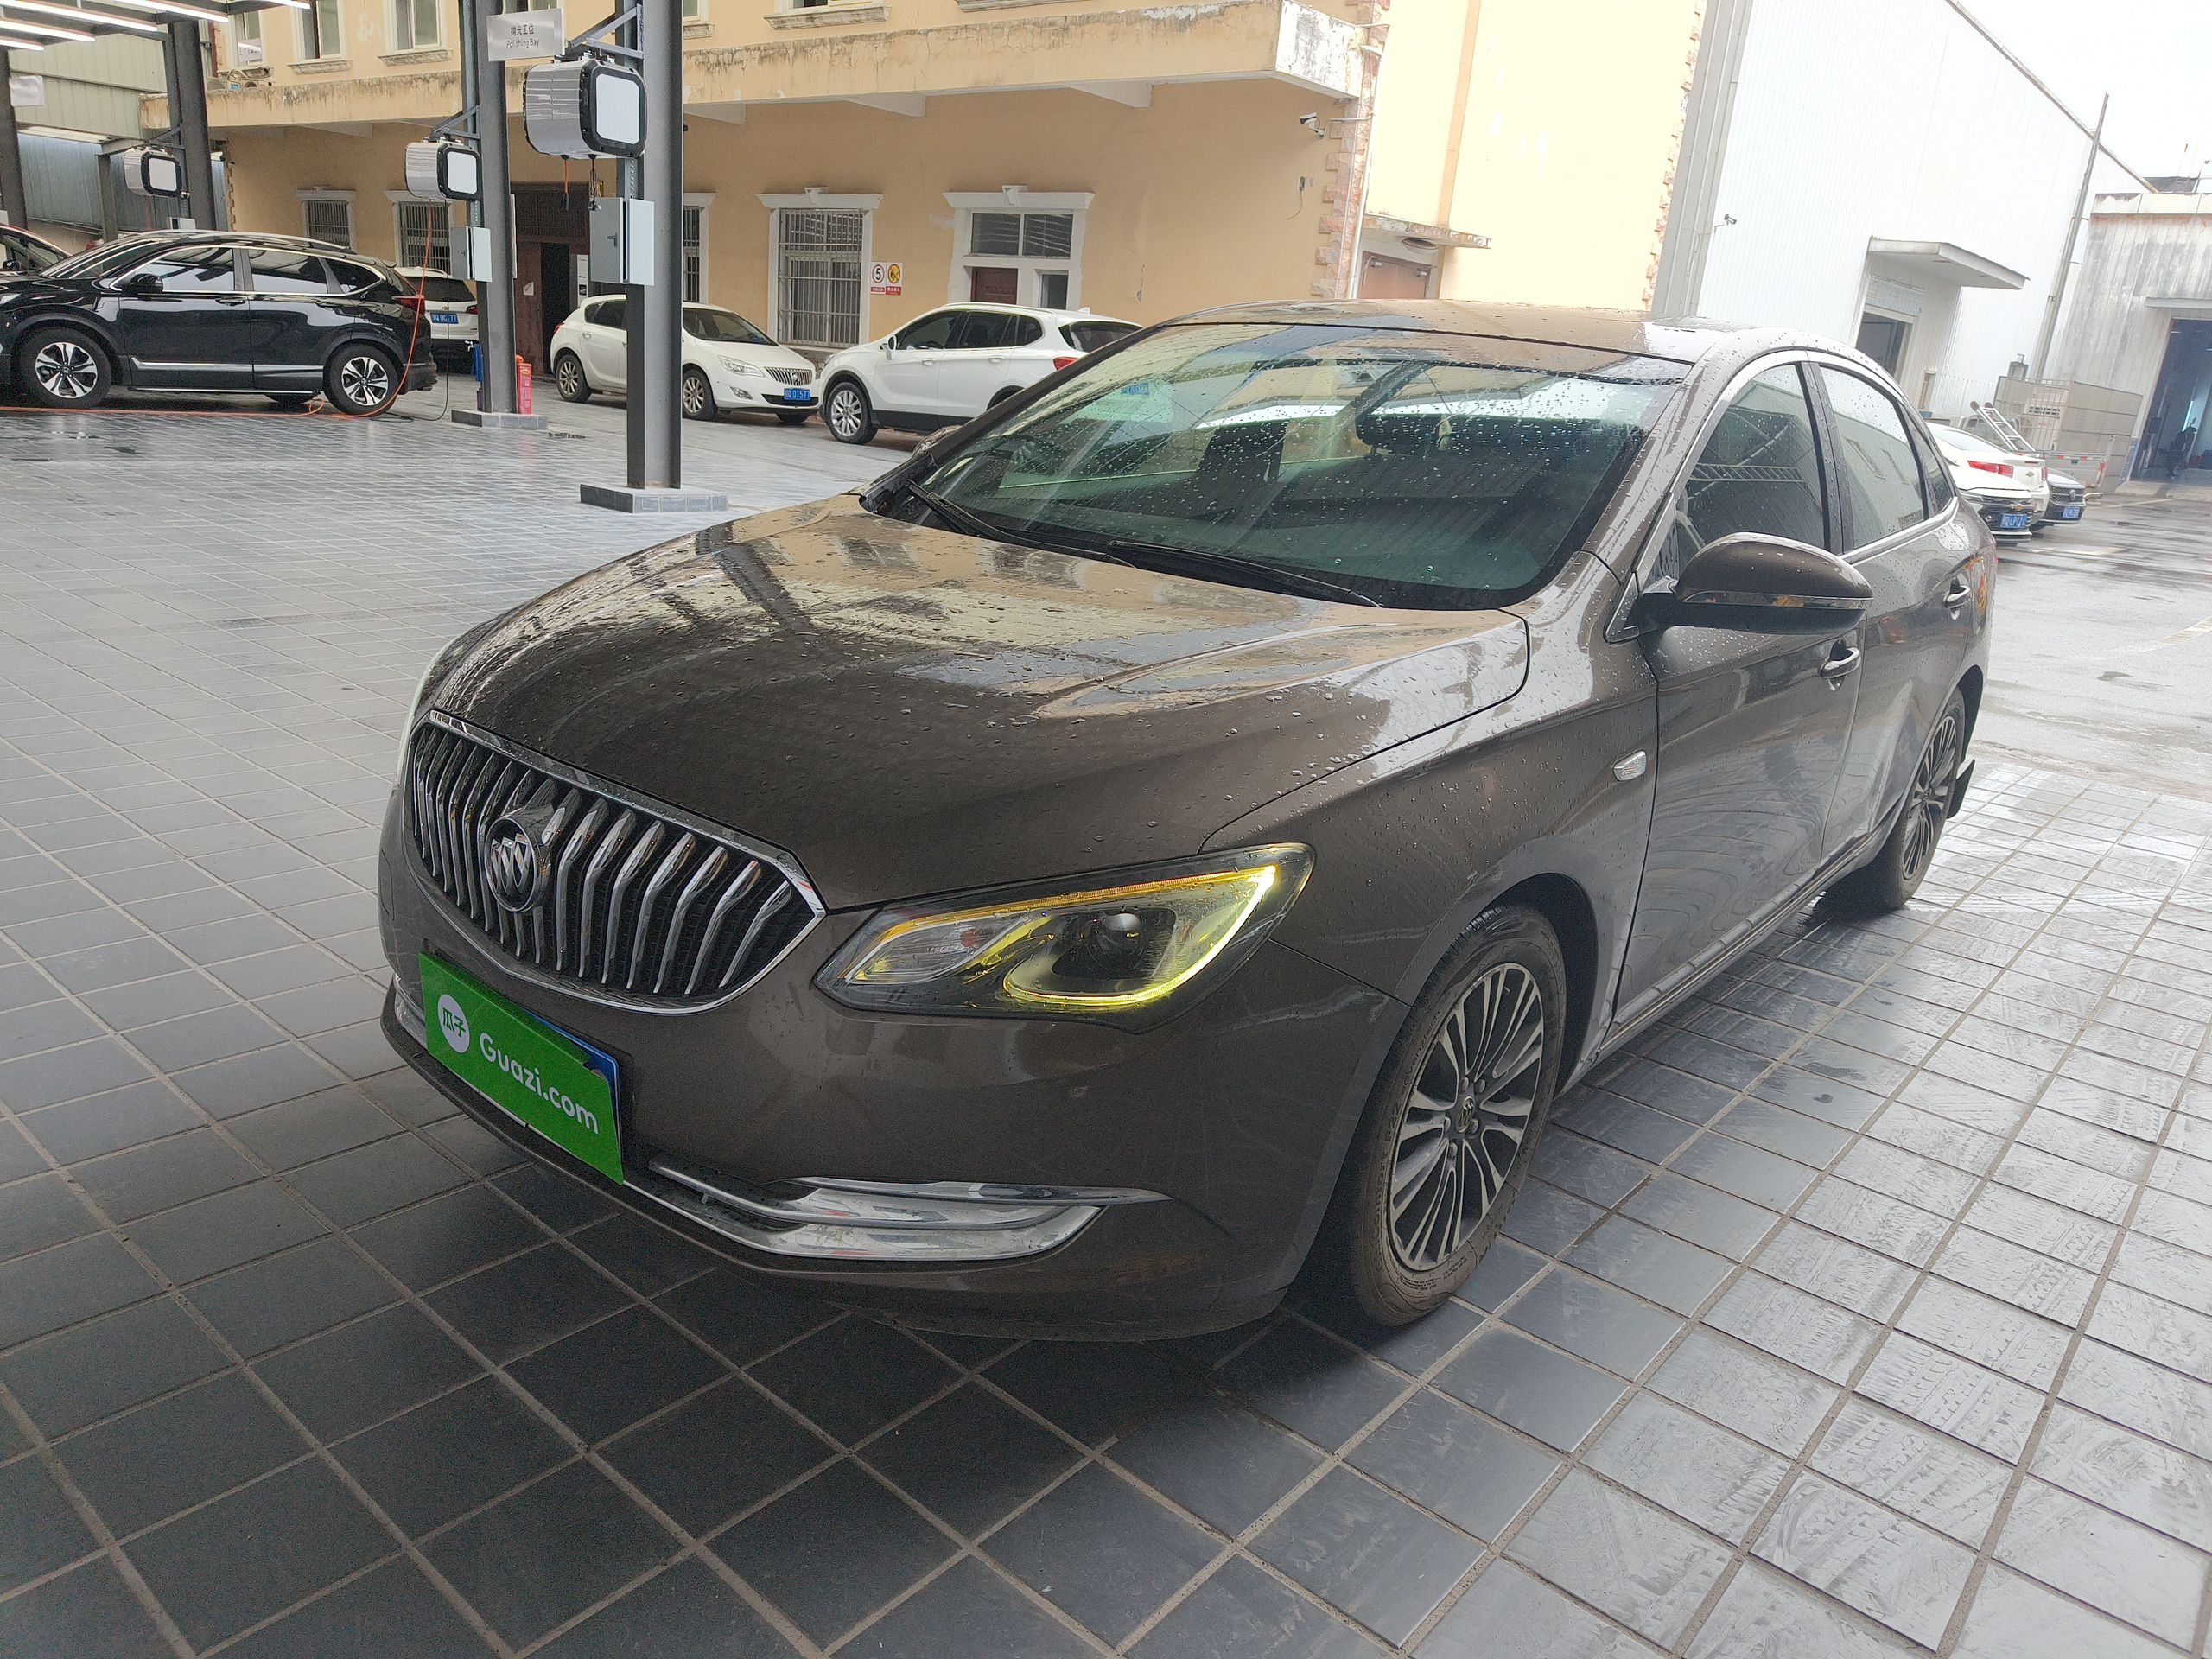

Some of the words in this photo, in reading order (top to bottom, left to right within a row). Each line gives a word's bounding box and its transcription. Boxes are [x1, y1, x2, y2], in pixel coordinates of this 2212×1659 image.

[506, 39, 529, 48] Polishing
[530, 38, 539, 48] Bay
[875, 268, 881, 281] 5
[442, 1007, 467, 1038] 瓜子
[480, 1033, 598, 1135] Guazi.com
